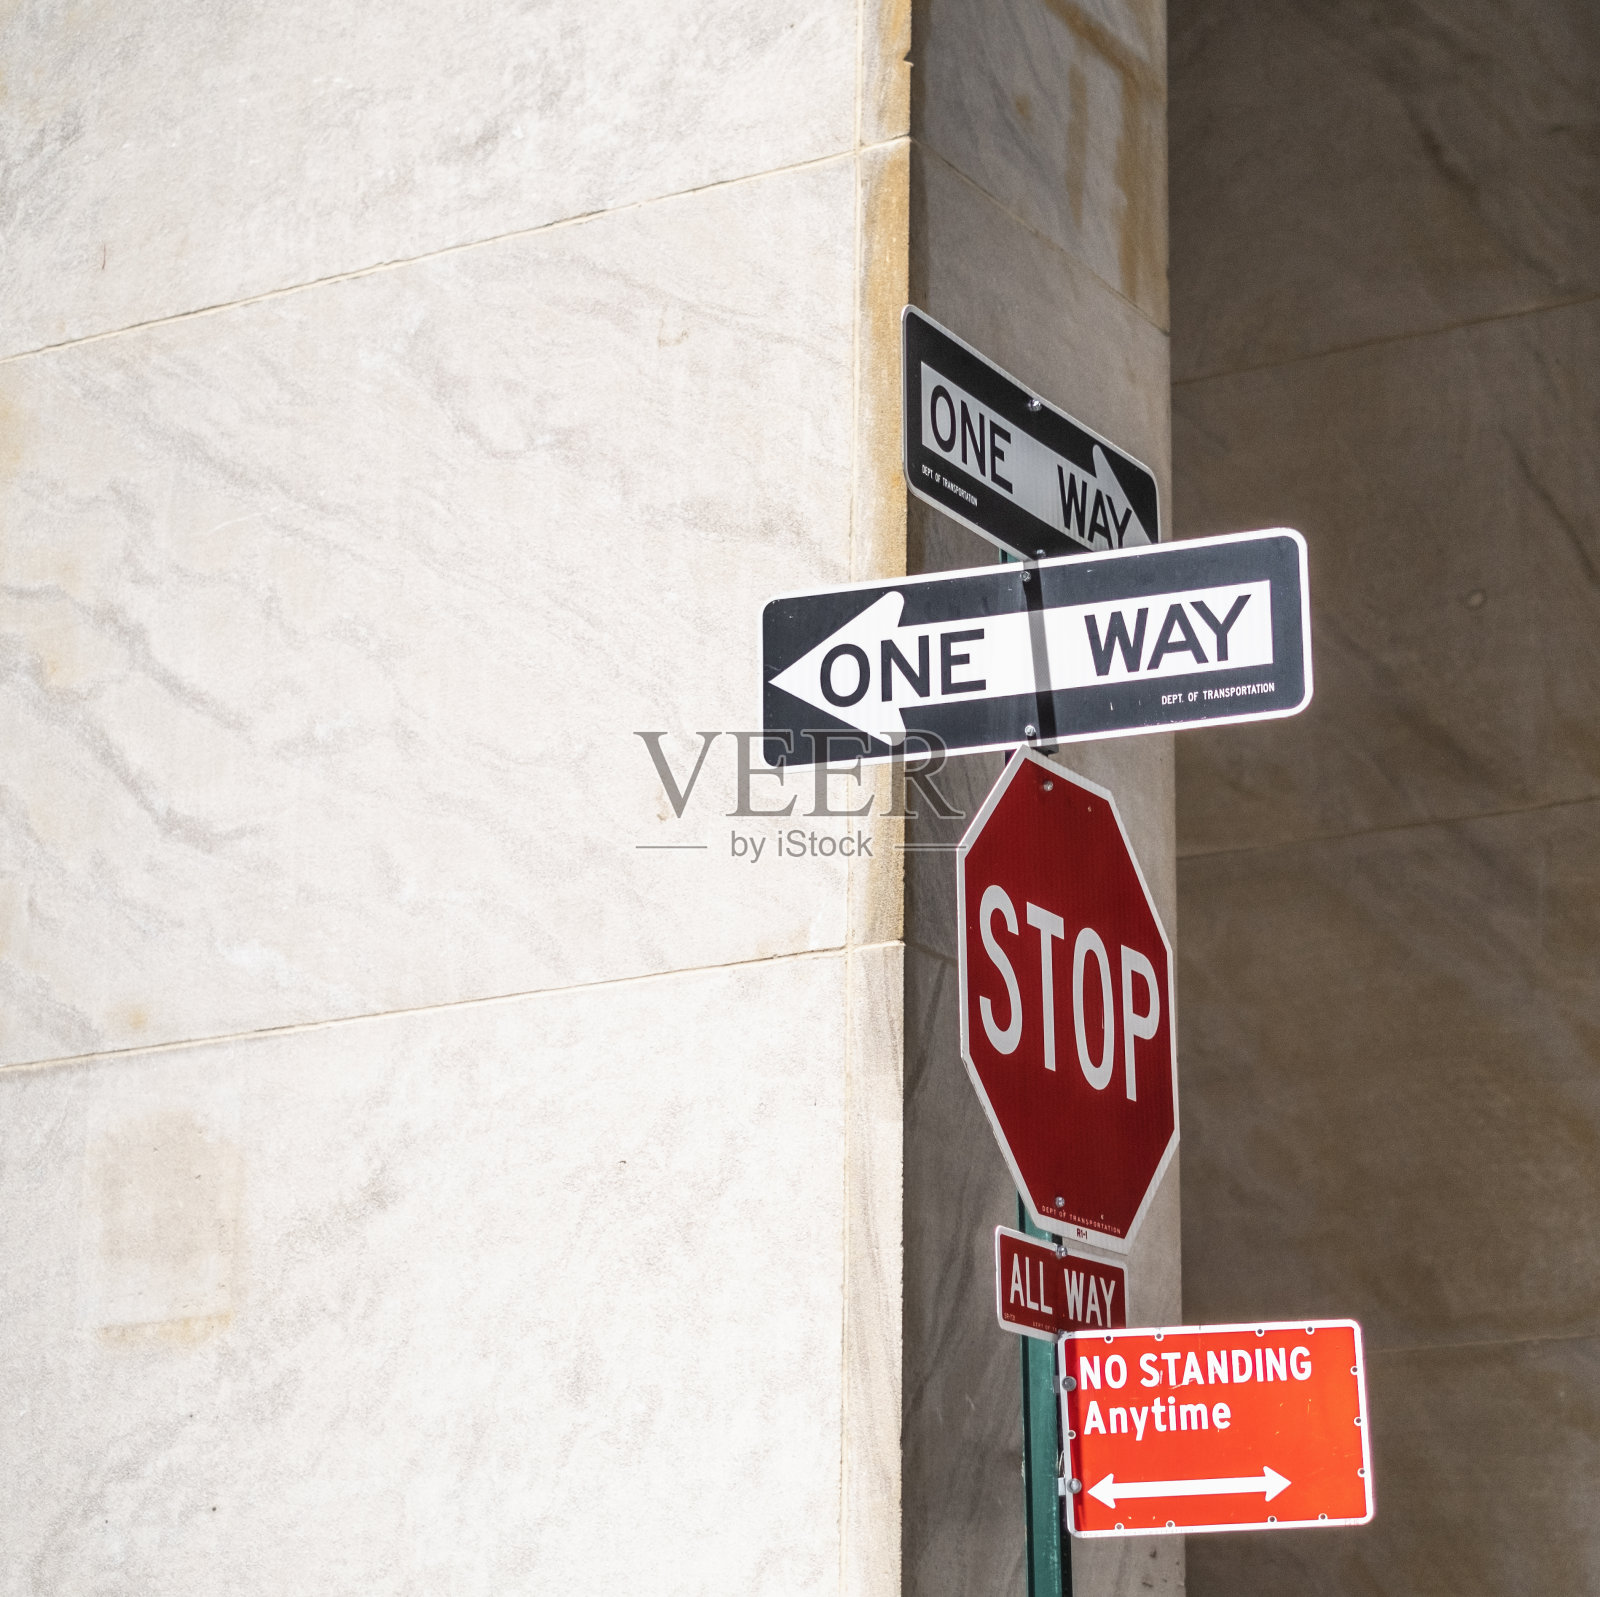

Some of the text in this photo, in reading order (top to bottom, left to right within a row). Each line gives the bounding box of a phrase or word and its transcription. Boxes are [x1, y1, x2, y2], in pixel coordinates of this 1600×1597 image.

[930, 384, 1133, 550] ONE WAY
[935, 472, 941, 483] OF
[942, 476, 978, 508] TRANSPORTATION
[819, 594, 1252, 708] ONE WAY
[1161, 682, 1275, 705] DEPT. OF TRANSPORTATION
[979, 884, 1160, 1102] STOP
[1059, 1210, 1066, 1219] OF
[1069, 1213, 1121, 1234] TRANSPORTATION
[1009, 1253, 1116, 1328] ALL WAY
[1079, 1346, 1312, 1391] NO STANDING
[1084, 1396, 1232, 1441] Anytime
